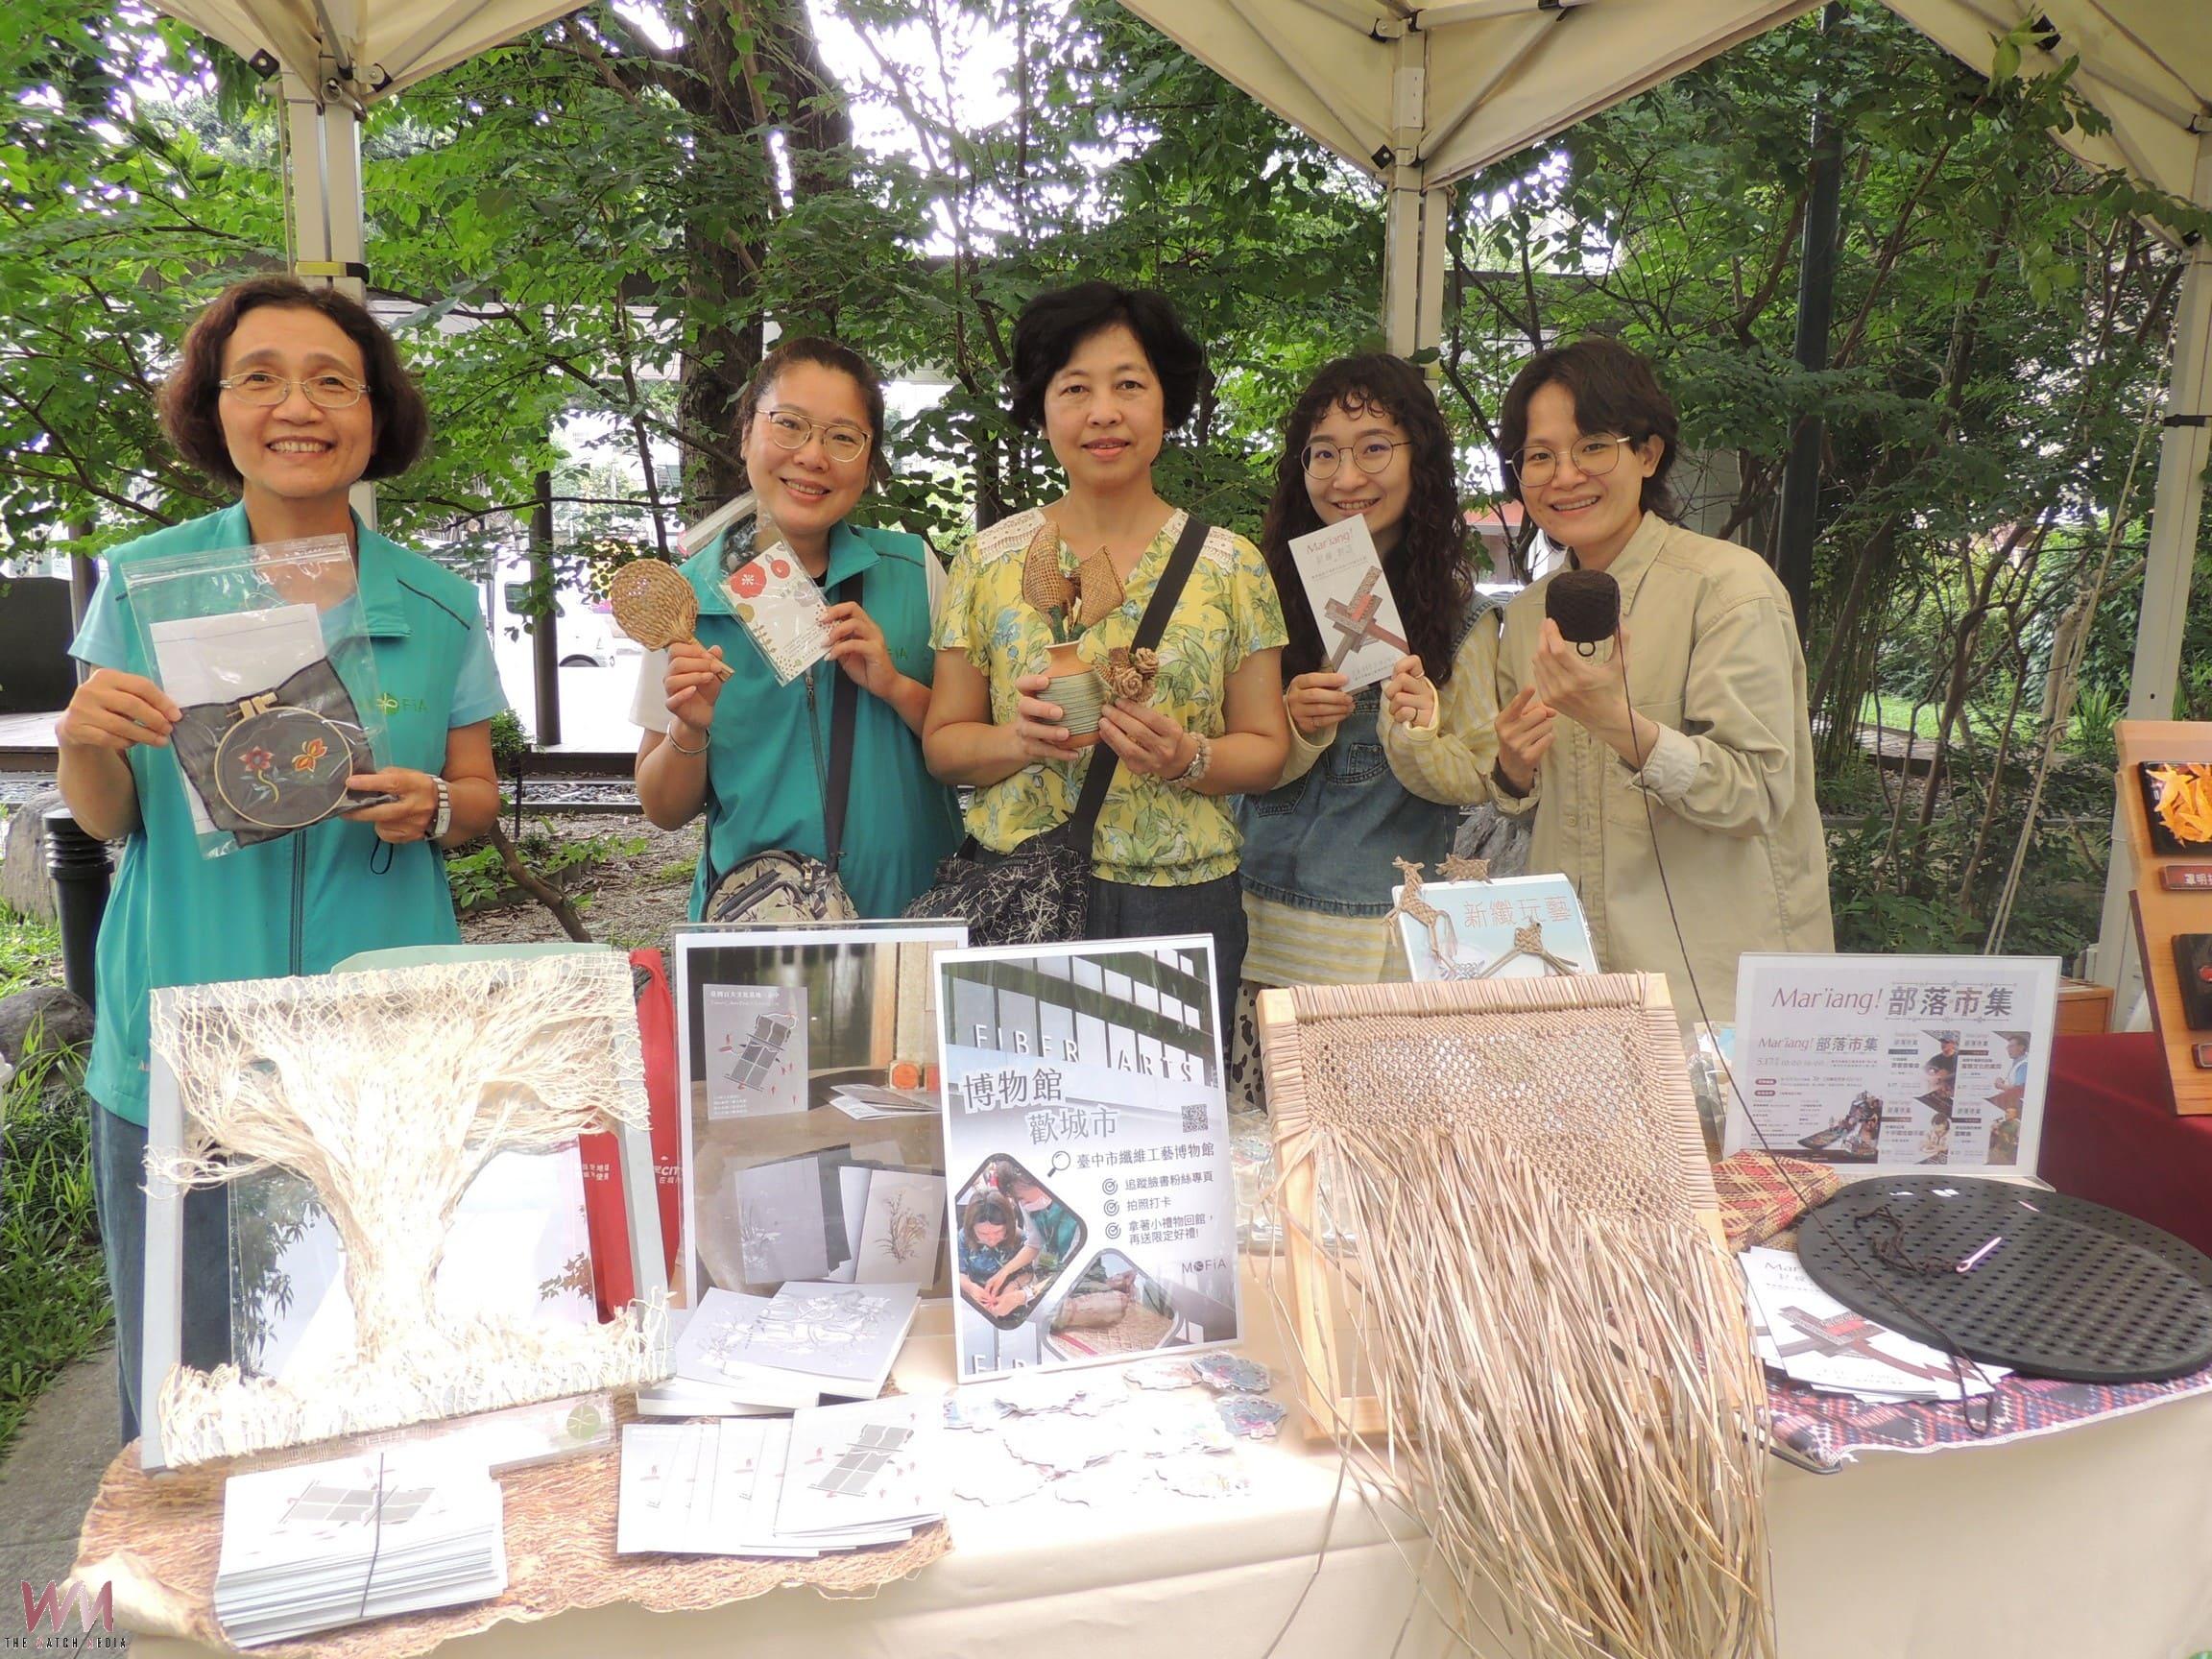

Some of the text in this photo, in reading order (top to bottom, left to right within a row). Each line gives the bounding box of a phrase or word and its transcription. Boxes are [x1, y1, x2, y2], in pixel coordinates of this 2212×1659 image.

[1887, 986, 2013, 1016] 部落市集
[974, 1023, 1080, 1063] FIBER
[1118, 1048, 1192, 1082] ARTS
[1815, 1036, 1879, 1052] 部落市集
[963, 1068, 1063, 1109] 博物館
[1028, 1107, 1118, 1145] 歡城市
[1076, 1142, 1214, 1169] 臺中市纖維工藝博物館
[1125, 1170, 1214, 1190] 追蹤臉書粉絲專頁
[1126, 1196, 1172, 1212] 拍照打卡
